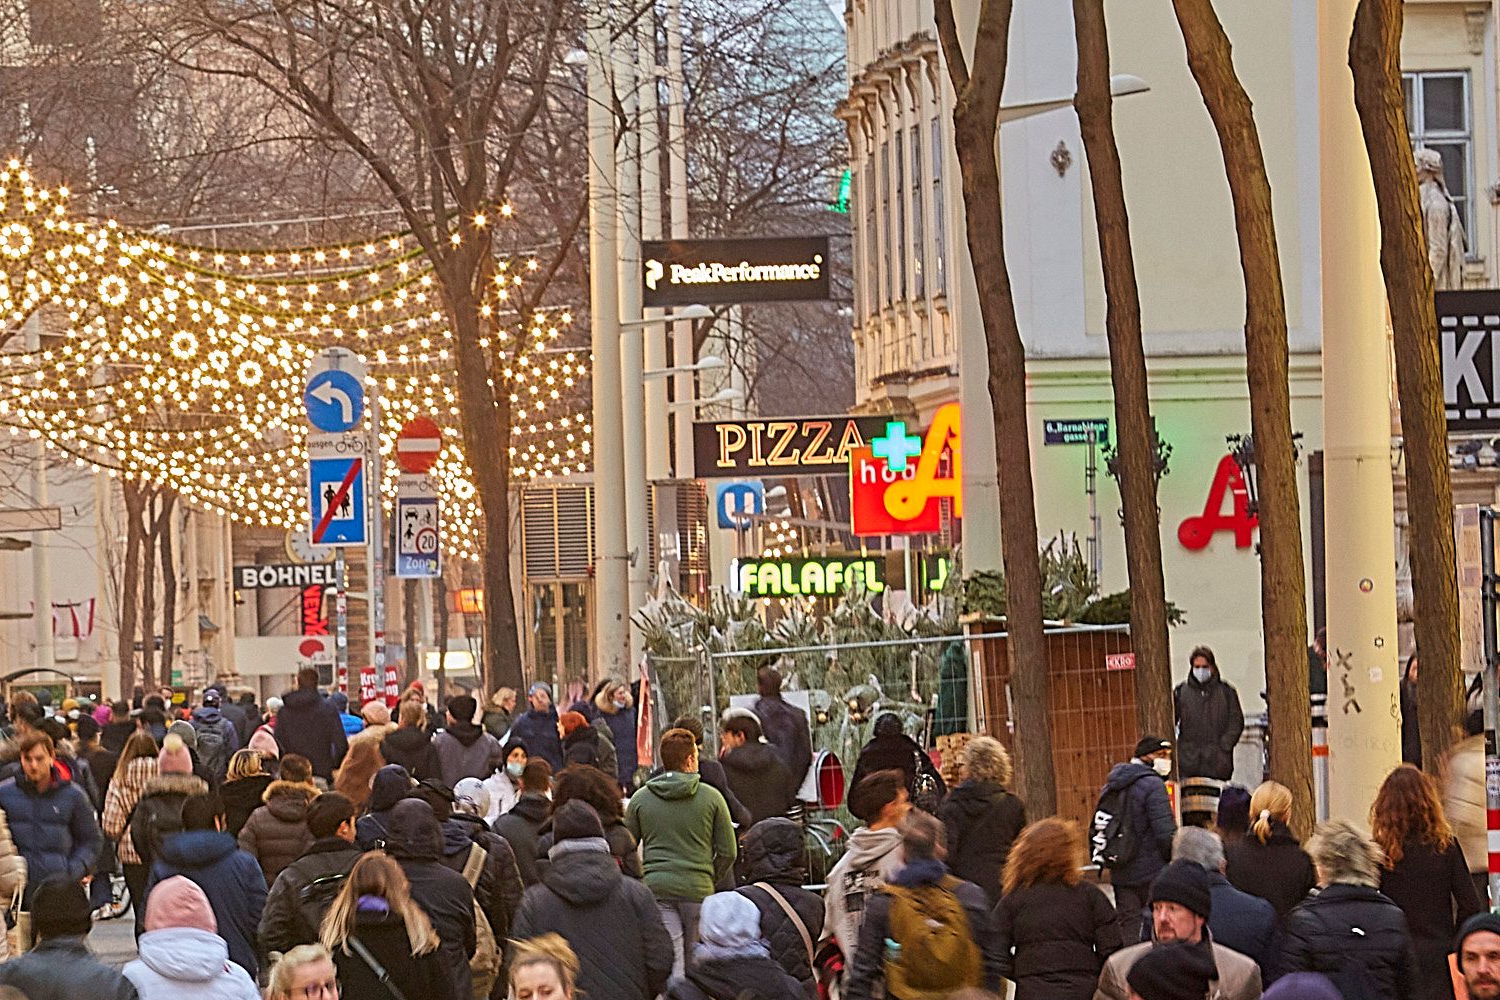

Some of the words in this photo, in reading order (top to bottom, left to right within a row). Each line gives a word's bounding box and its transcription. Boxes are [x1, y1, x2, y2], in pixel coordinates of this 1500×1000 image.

[670, 260, 820, 284] PeakPerformance
[715, 420, 865, 468] PIZZA
[421, 535, 435, 550] 20
[739, 560, 885, 596] FALAFEL
